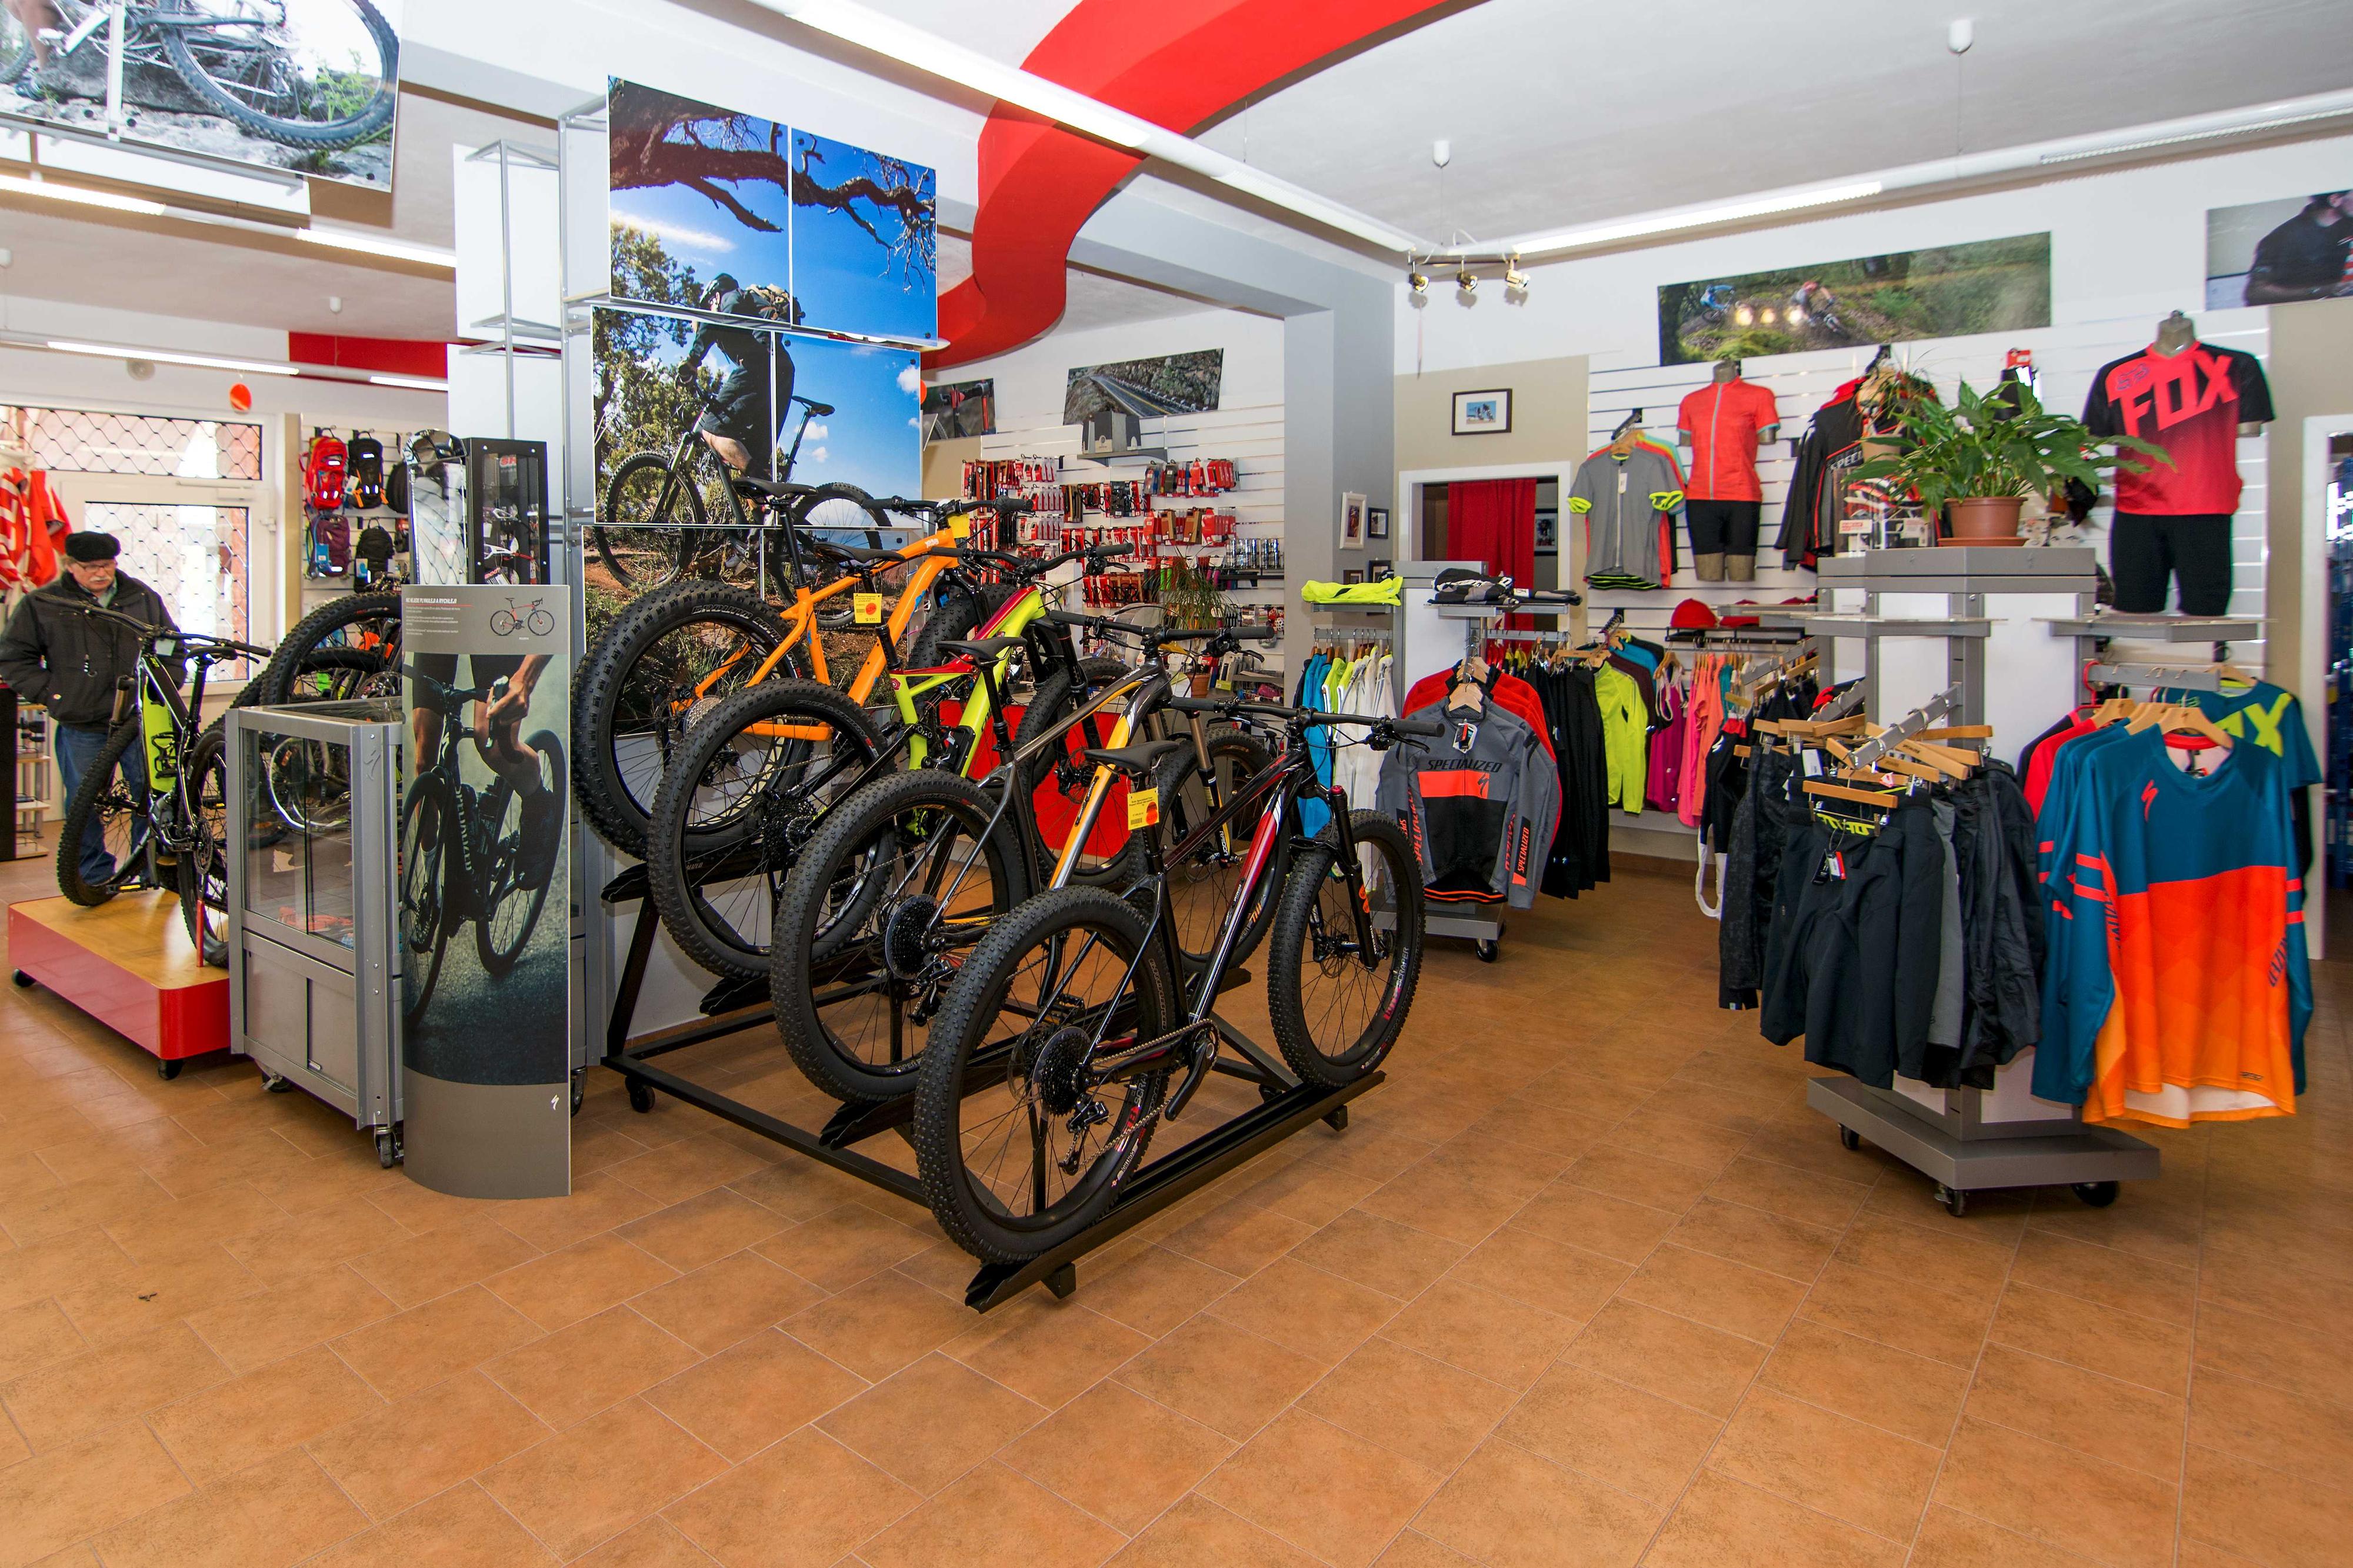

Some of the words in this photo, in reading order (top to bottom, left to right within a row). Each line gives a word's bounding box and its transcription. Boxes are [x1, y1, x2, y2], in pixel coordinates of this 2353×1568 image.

[2105, 348, 2238, 438] FOX
[1426, 759, 1503, 773] SPECIALIZED
[1518, 827, 1529, 873] SPECIALIZED
[1394, 947, 1409, 989] SCRAPER
